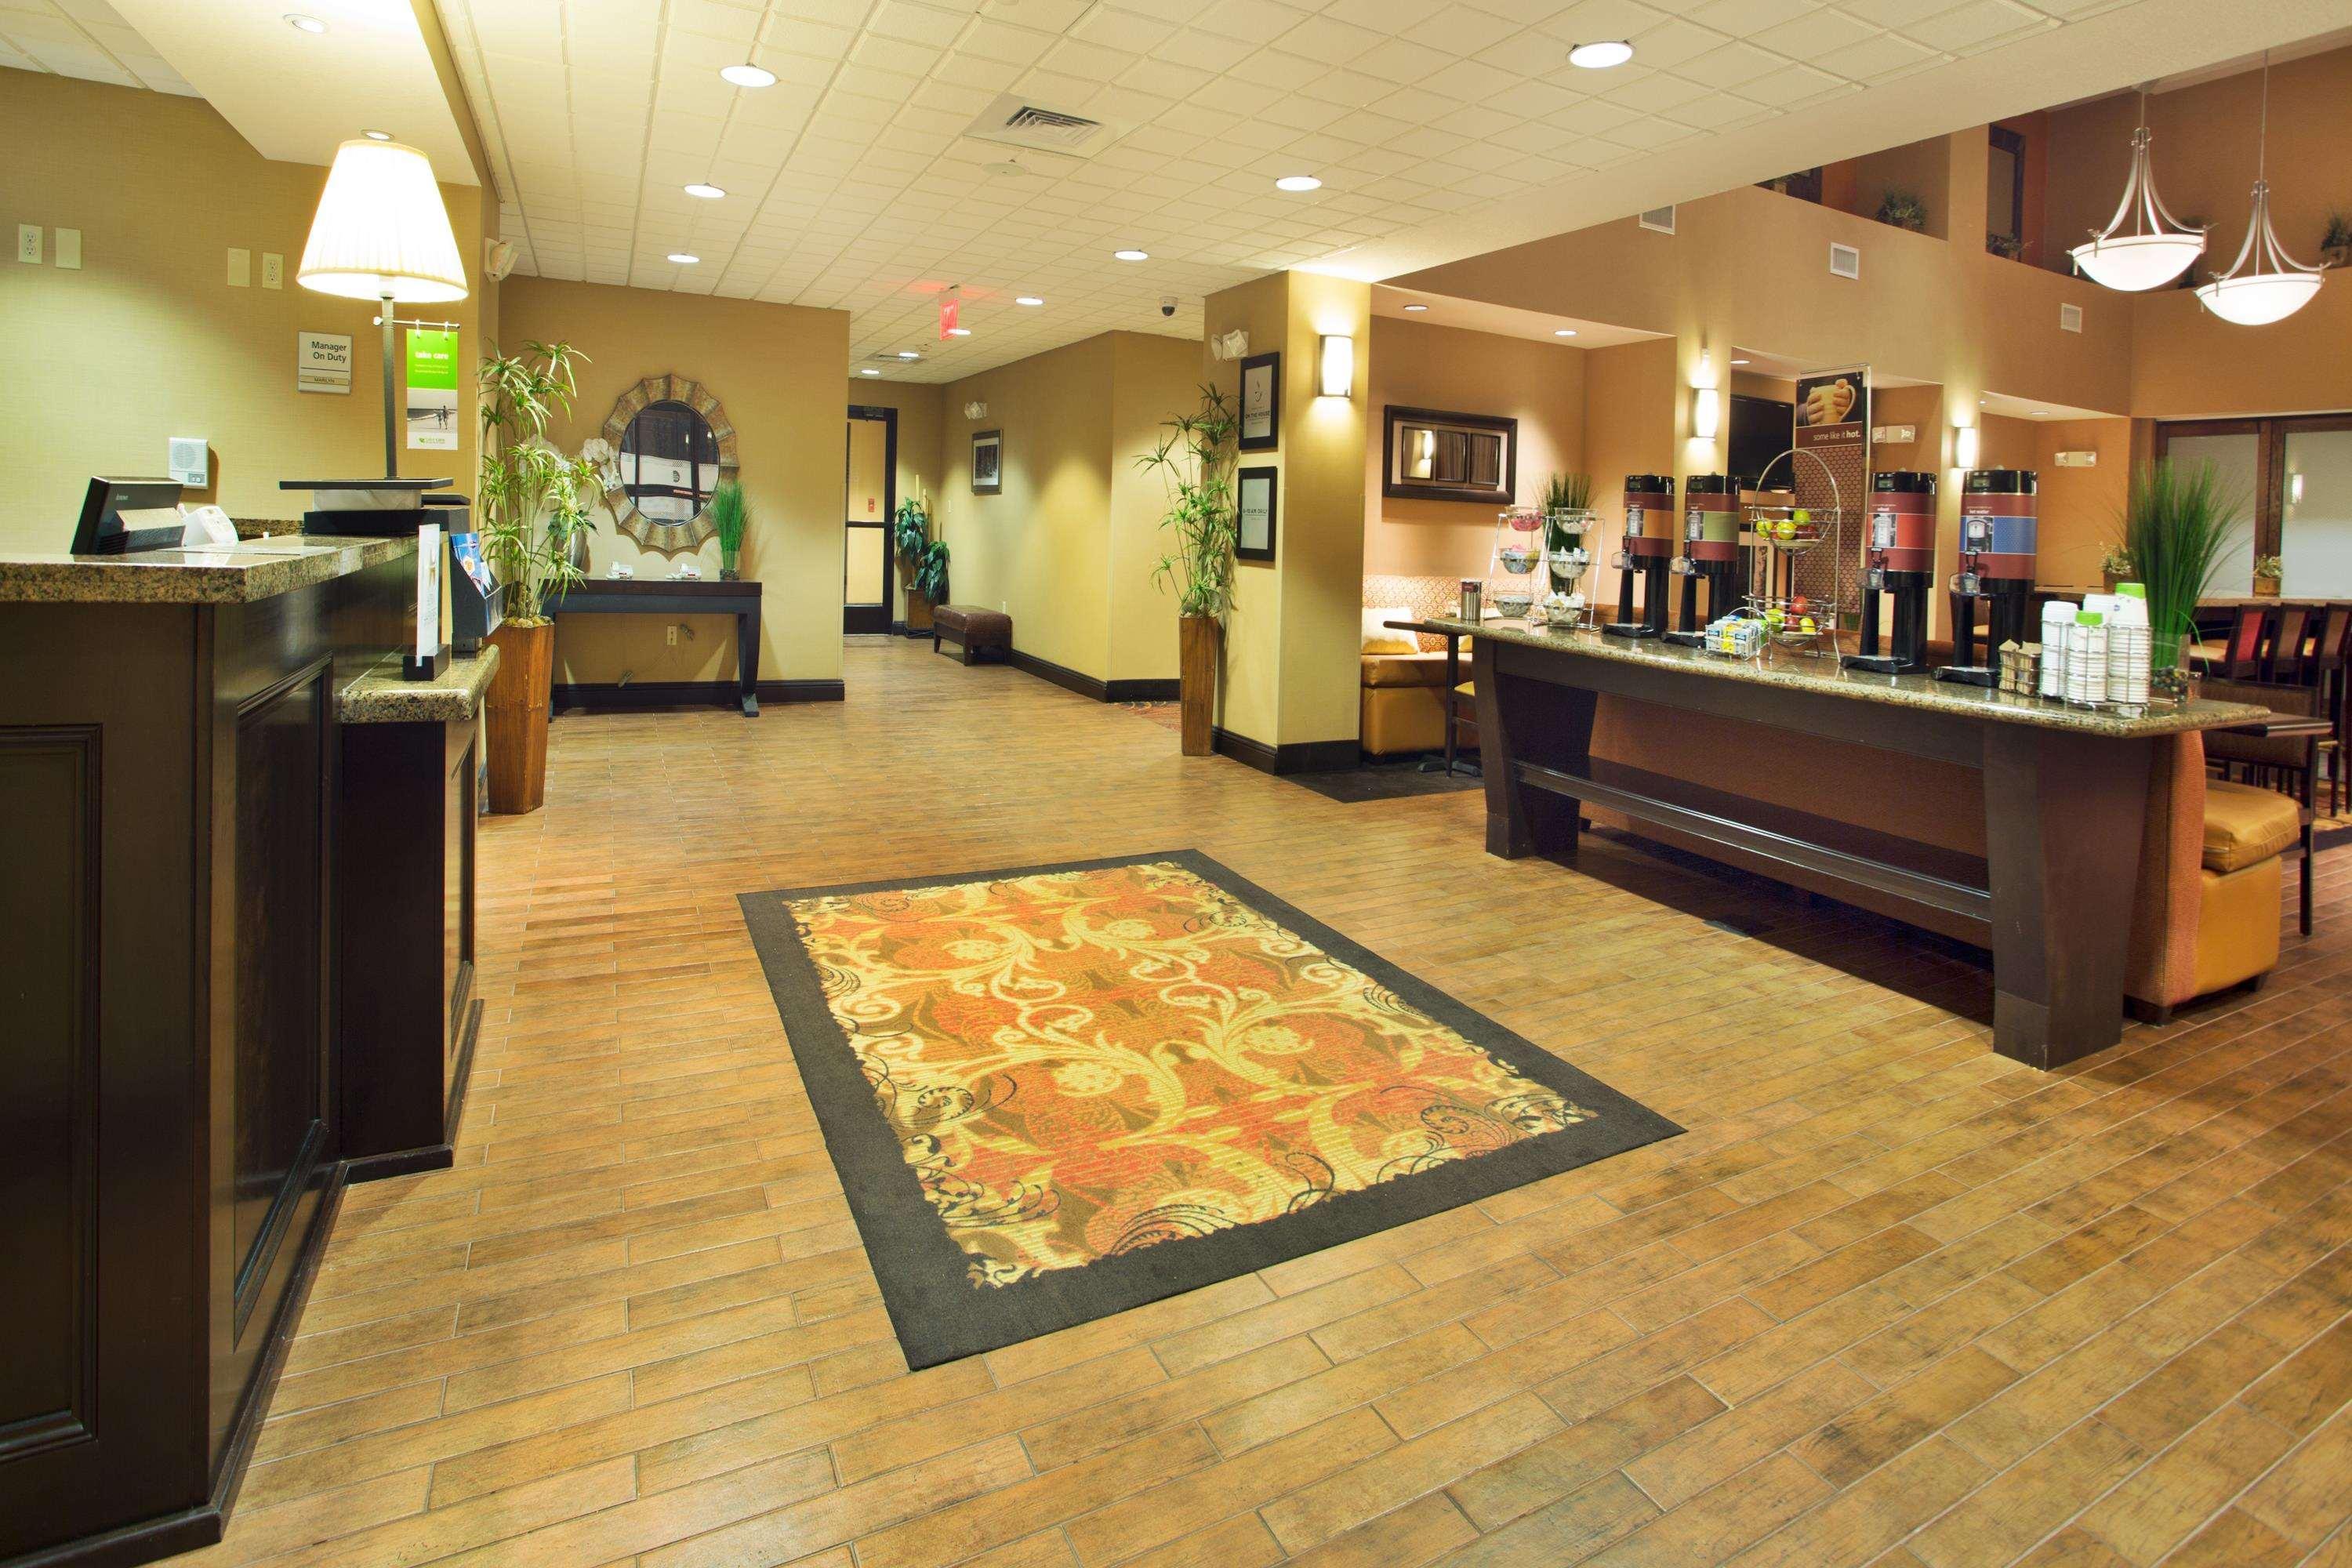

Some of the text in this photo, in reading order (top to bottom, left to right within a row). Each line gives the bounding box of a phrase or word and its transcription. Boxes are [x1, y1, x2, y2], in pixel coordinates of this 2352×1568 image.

[311, 341, 347, 352] Manager
[314, 351, 347, 363] On Duty
[1846, 430, 1861, 438] hot.
